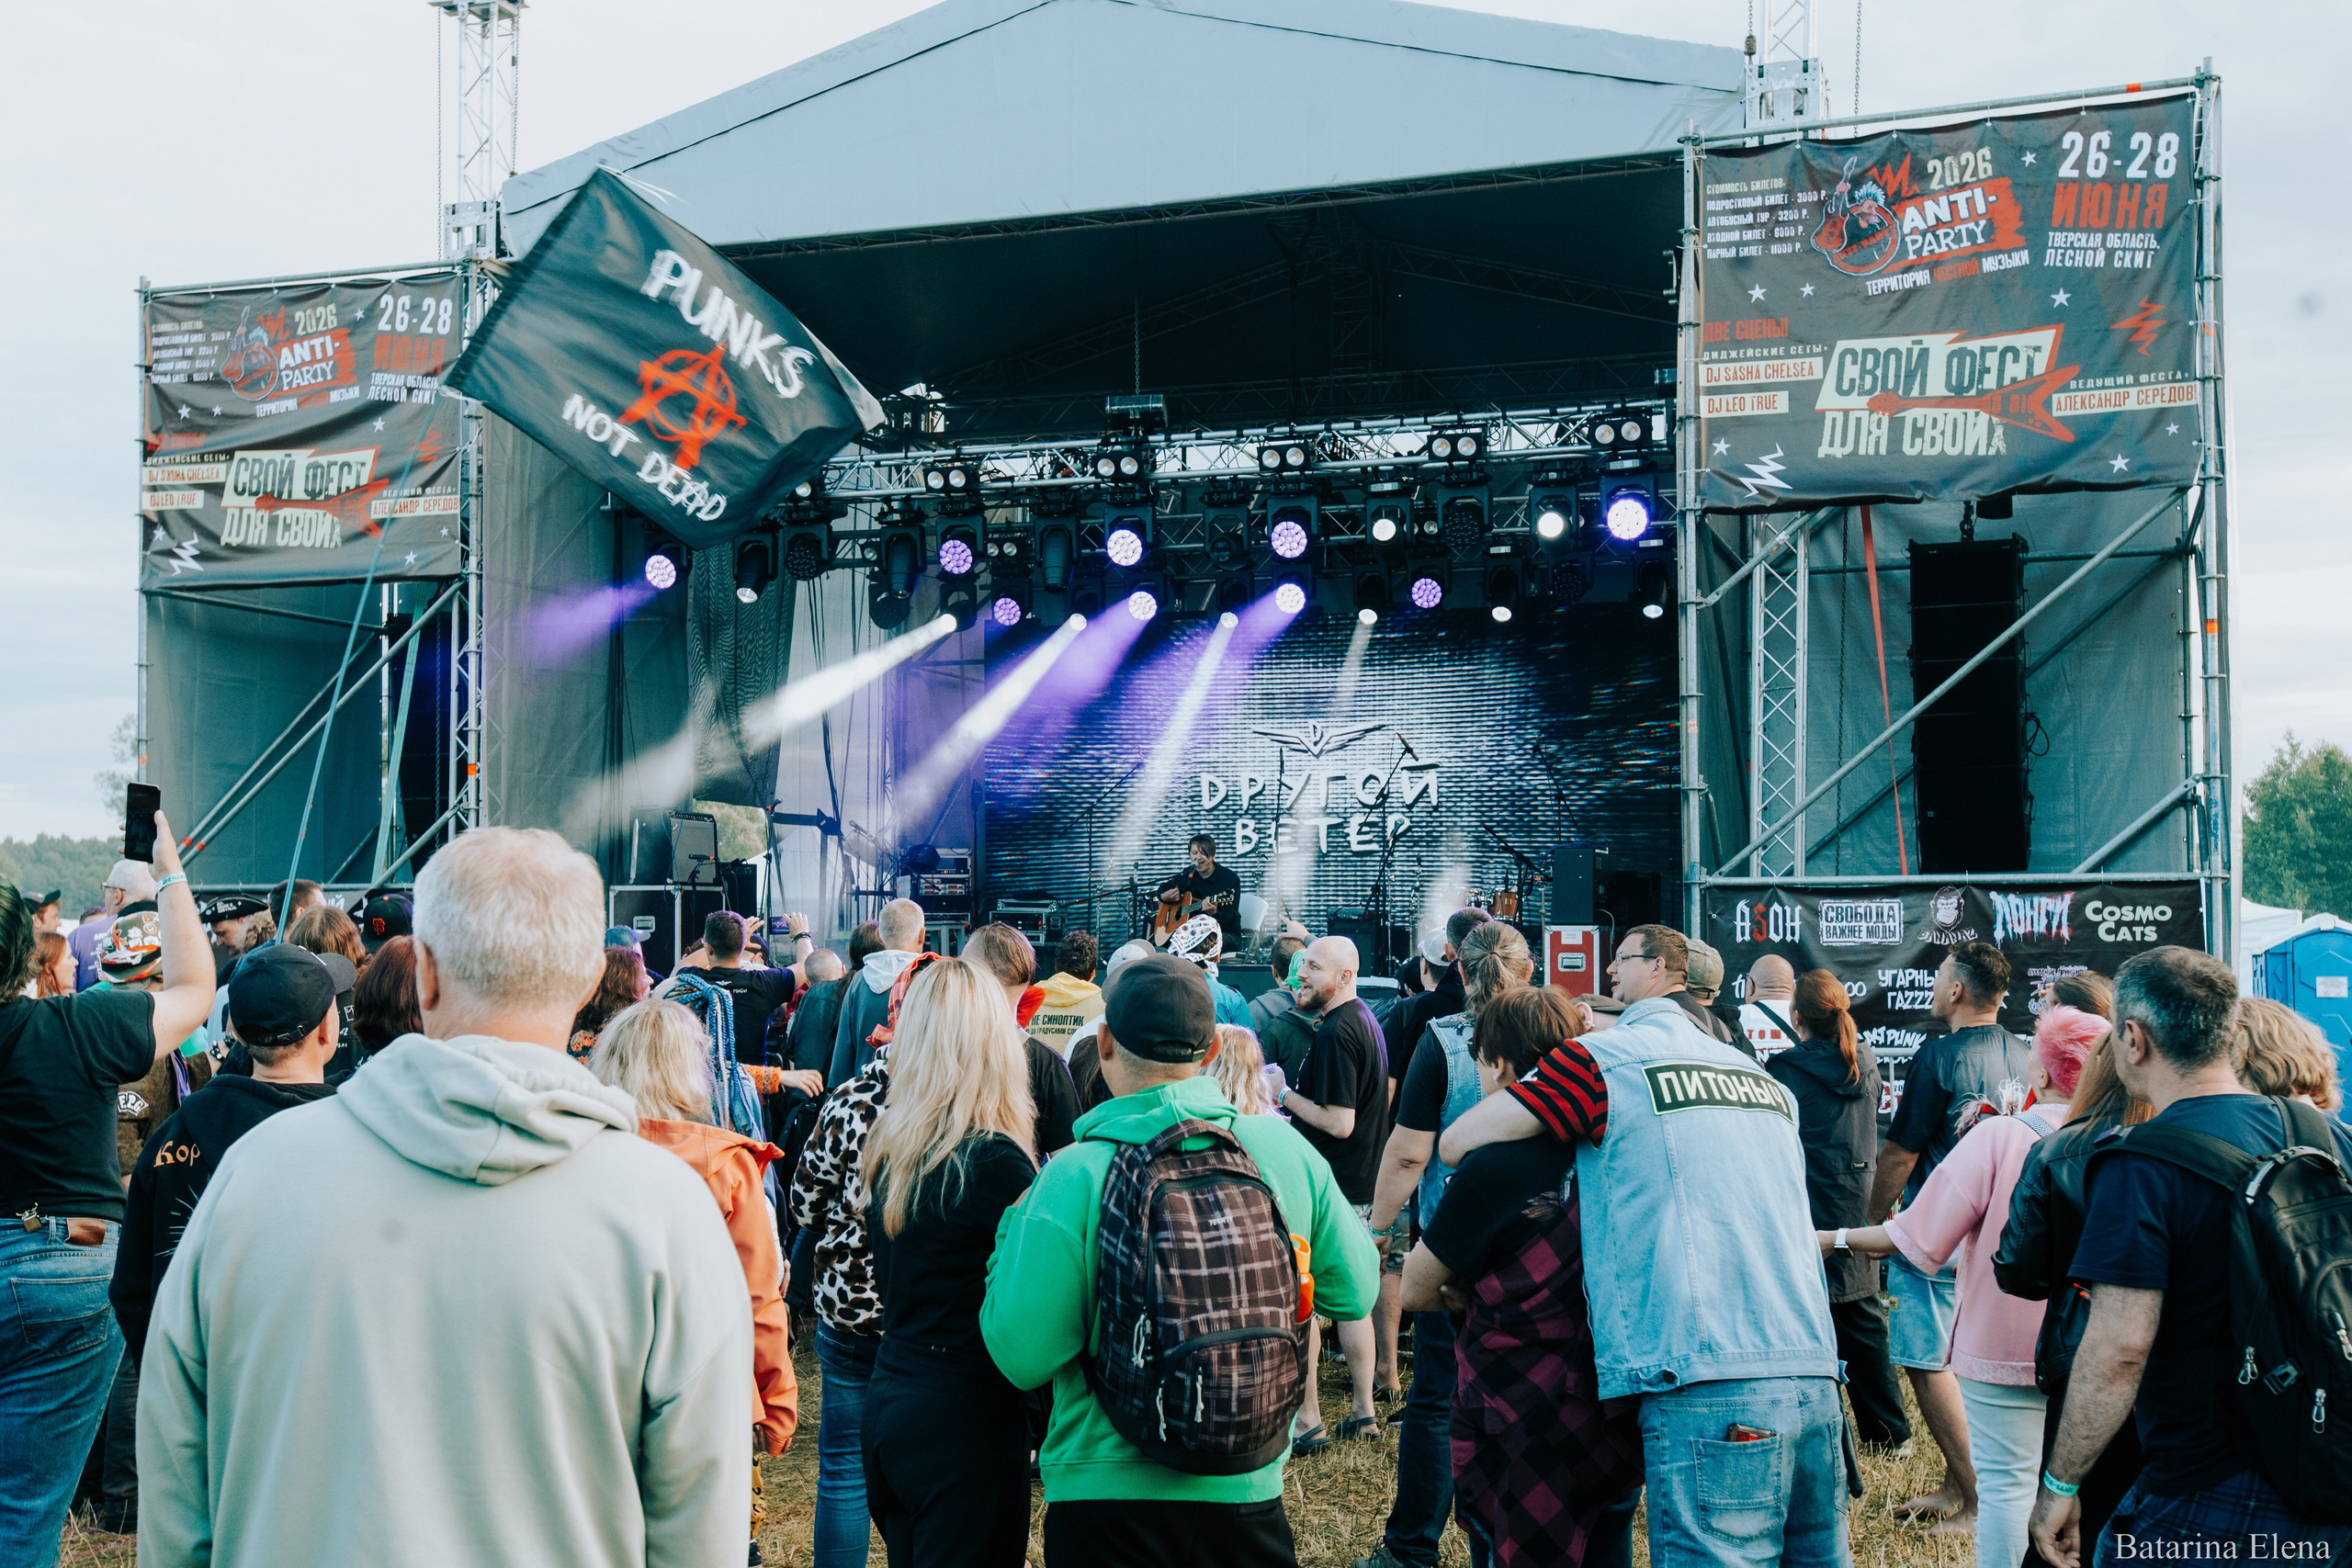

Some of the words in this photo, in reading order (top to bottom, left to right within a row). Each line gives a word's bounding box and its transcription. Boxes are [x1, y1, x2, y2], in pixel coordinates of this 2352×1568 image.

[1927, 146, 1994, 190] 2026
[2058, 130, 2180, 179] 26-28
[1765, 194, 1789, 206] БИЛЕТ
[1797, 190, 1818, 203] 3000
[1902, 186, 1998, 235] ANTI-
[2051, 181, 2168, 229] ИЮНЯ
[1757, 212, 1770, 223] ТУР
[1778, 209, 1799, 221] 3200
[1742, 229, 1766, 240] БИЛЕТ
[1905, 219, 1987, 260] PARTY
[2048, 231, 2103, 248] ТВЕРСКАЯ
[1706, 246, 1736, 259] ПАРНЫЙ
[1739, 245, 1762, 257] БИЛЕТ
[2043, 247, 2106, 268] ЛЕСНОЙ
[2113, 250, 2154, 269] СКИТ
[1865, 269, 1931, 296] ТЕРРИТОРИЯ
[1982, 249, 2030, 274] МУЗЫКИ
[294, 302, 338, 336] 2026
[378, 294, 453, 335] 26-28
[639, 248, 818, 399] PUNKS
[1702, 321, 1731, 344] ДВЕ
[279, 334, 341, 370] ANTI-
[373, 333, 446, 375] ИЮНЯ
[1702, 346, 1785, 362] ДИДЖЕЙСКИЕ
[280, 360, 334, 391] PARTY
[371, 372, 405, 387] ТВЕРСКАЯ
[1706, 367, 1721, 383] DJ
[1724, 364, 1761, 381] SASHA
[1764, 360, 1815, 379] CHELSEA
[1836, 339, 1930, 397] СВОЙ
[1944, 345, 2042, 396] ФЕСТ
[2069, 374, 2134, 389] ВЕДУЩИЙ
[368, 386, 408, 402] ЛЕСНОЙ
[412, 389, 437, 405] СКИТ
[1707, 398, 1723, 414] DJ
[1725, 396, 1746, 412] LEO
[1750, 393, 1779, 412] TRUE
[2055, 390, 2131, 412] АЛЕКСАНДР
[560, 392, 641, 458] NOT
[1817, 410, 1888, 458] ДЛЯ
[1902, 409, 2007, 456] СВОИХ
[233, 453, 296, 499] СВОЙ
[304, 458, 367, 501] ФЕСТ
[636, 450, 728, 523] DEAD
[220, 507, 270, 547] ДЛЯ
[276, 508, 343, 548] СВОИХ
[1733, 898, 1803, 944] АЗОН
[1825, 905, 1897, 924] СВОБОДА
[1825, 926, 1863, 940] ВАЖНЕЕ
[1865, 924, 1897, 940] МОДЫ
[1878, 968, 1940, 988] УГАРНЫ
[1042, 1014, 1085, 1027] СИНОПТИК
[1886, 1028, 1928, 1049] PUNK
[1656, 1069, 1789, 1113] ПИТОНЫЧ
